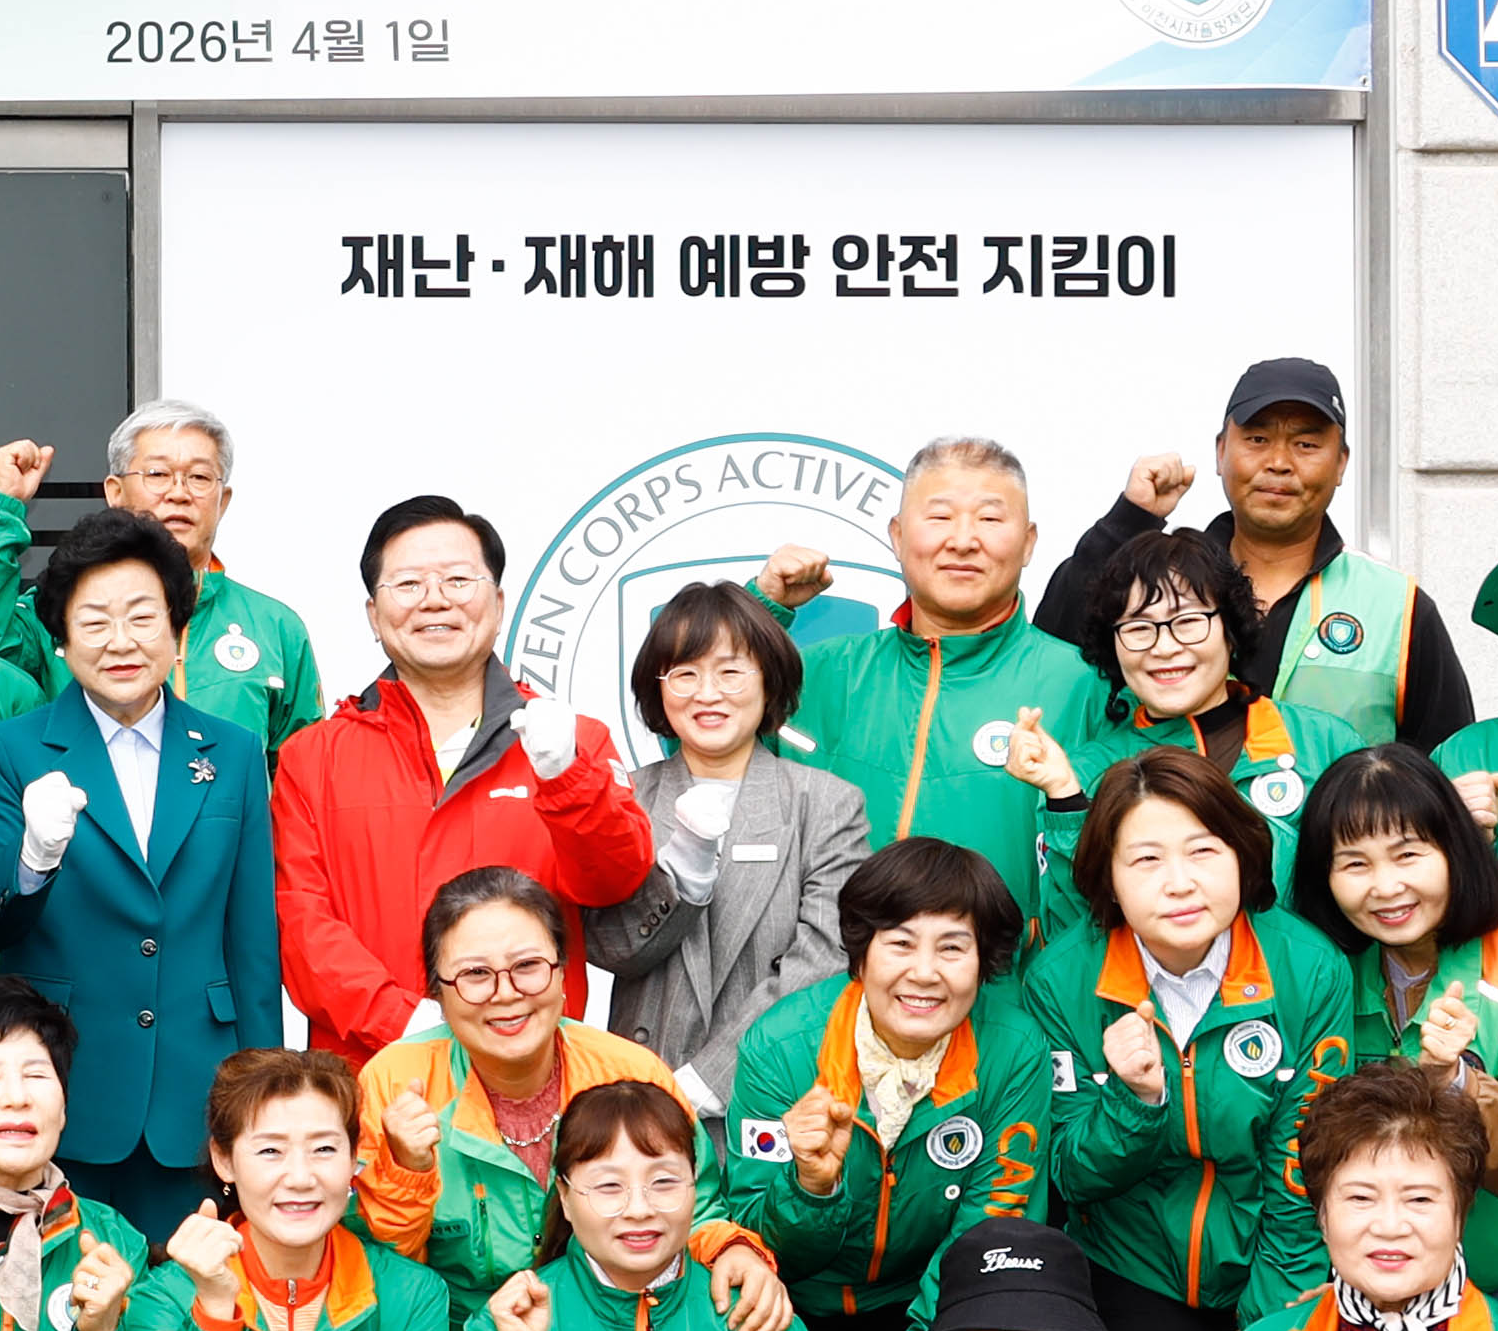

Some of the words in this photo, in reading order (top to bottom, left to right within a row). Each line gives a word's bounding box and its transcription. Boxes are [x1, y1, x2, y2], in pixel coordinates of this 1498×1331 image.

[107, 19, 273, 64] 2026년
[292, 19, 365, 63] 4월
[386, 19, 450, 62] 1일
[679, 233, 811, 298] 예방
[832, 233, 959, 298] 안전
[982, 234, 1177, 298] 지킴이
[558, 463, 703, 586] CORPS
[717, 450, 892, 518] ACTIVE
